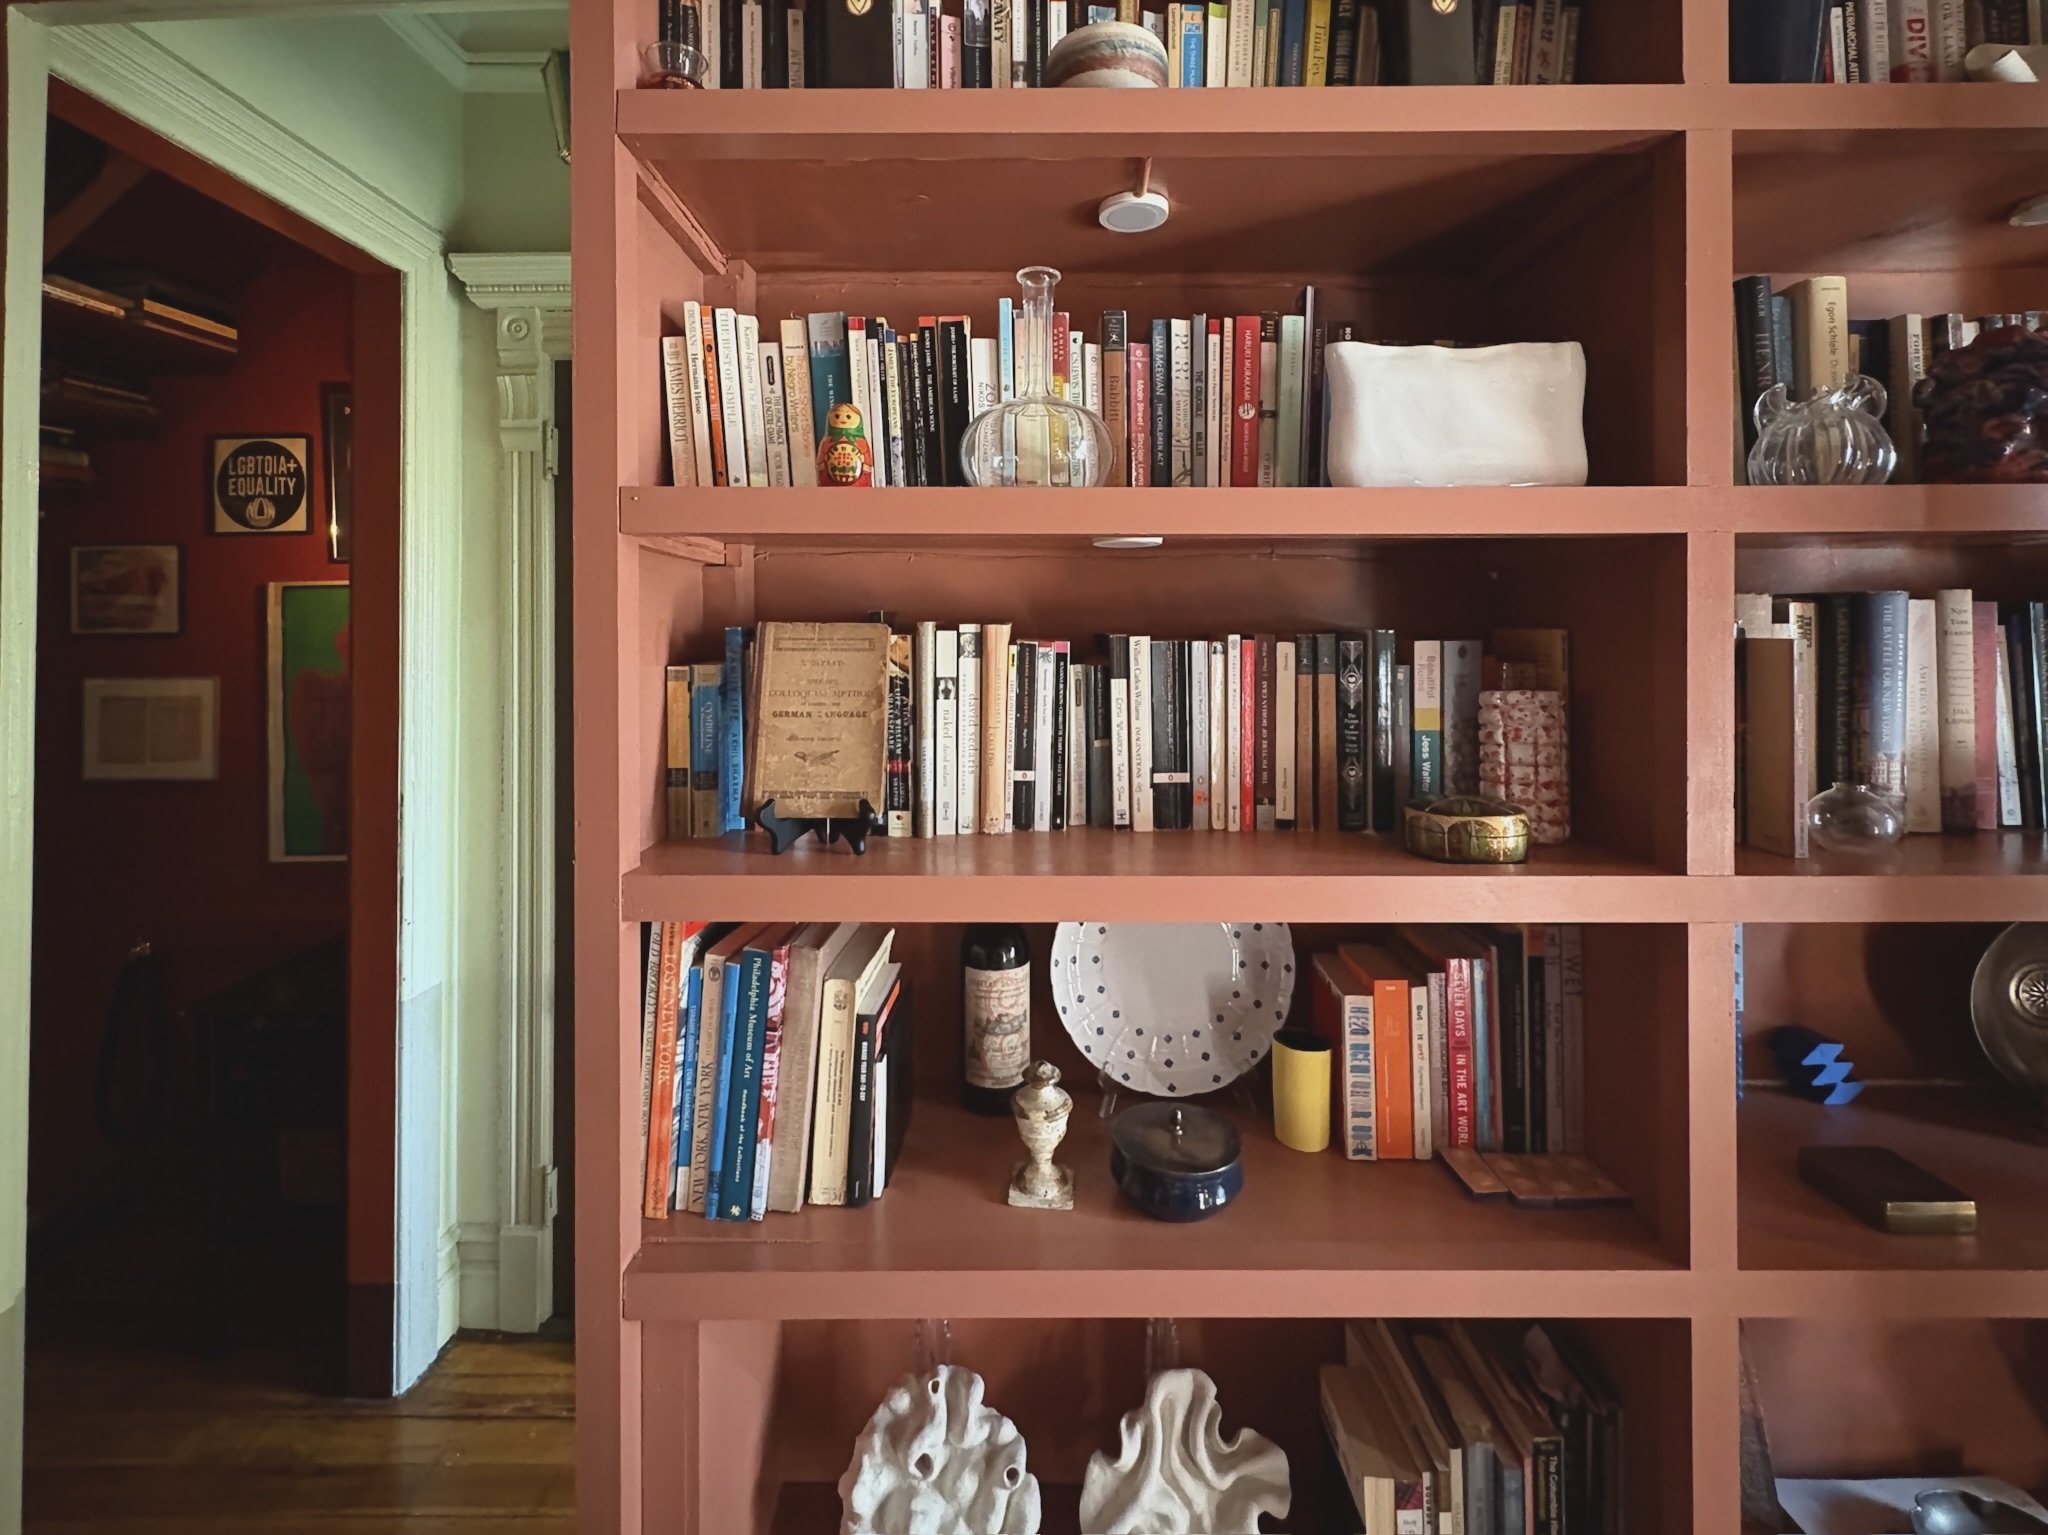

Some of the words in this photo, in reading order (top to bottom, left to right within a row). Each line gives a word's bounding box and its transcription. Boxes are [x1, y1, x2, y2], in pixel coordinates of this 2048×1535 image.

[1314, 24, 1327, 53] Tina
[1845, 2, 1857, 60] PATRIARCHAL
[1310, 55, 1325, 77] Fey
[1756, 285, 1766, 317] UNGER
[1828, 302, 1838, 324] Egon
[687, 309, 697, 347] DEMIAN
[718, 311, 730, 334] THE
[744, 326, 755, 350] Kazuo
[1155, 335, 1163, 353] IAN
[1244, 330, 1252, 357] HARUKI
[1829, 326, 1840, 356] Schiele
[720, 338, 732, 368] BEST
[744, 351, 756, 384] Ishiguro
[796, 355, 807, 372] The
[887, 348, 895, 370] JAMES
[667, 357, 687, 394] JAMES
[689, 353, 701, 389] Hermann
[723, 370, 733, 383] OF
[786, 367, 797, 398] Negro
[796, 373, 808, 395] Best
[1155, 354, 1165, 396] McEWAN
[1195, 371, 1203, 384] THE
[1244, 359, 1252, 400] MURAKAMI
[694, 391, 702, 414] Hesse
[773, 396, 782, 410] THE
[979, 382, 987, 408] NIKOS
[1109, 375, 1120, 422] Babbitt
[1136, 380, 1146, 401] Main
[1195, 386, 1204, 418] CRUCIBLE
[674, 397, 691, 445] HERRIOT
[726, 386, 738, 428] SIMPLE
[790, 399, 800, 433] Writers
[798, 397, 811, 424] Short
[1136, 402, 1146, 426] Street
[766, 405, 775, 445] NOTRE-DAME
[774, 411, 784, 446] HUNCHBACK
[800, 425, 812, 458] Stories
[1136, 433, 1146, 461] Sinclair
[1195, 432, 1203, 456] MILLER
[228, 457, 297, 477] LGBTQIA+
[775, 451, 783, 470] VICTOR
[228, 477, 296, 497] EQUALITY
[775, 471, 783, 486] HUGO
[1883, 604, 1893, 626] THE
[1133, 639, 1142, 667] William
[1836, 608, 1849, 689] GREENWICH
[1883, 627, 1893, 664] BATTLE
[1134, 668, 1142, 690] Carlos
[1417, 664, 1426, 692] Ruins
[1425, 656, 1436, 699] Beautiful
[1882, 666, 1893, 687] FOR
[1918, 664, 1930, 716] AMERICA'S
[731, 697, 739, 721] LIFE
[967, 694, 979, 726] david
[1135, 691, 1143, 721] Williams
[1882, 690, 1892, 716] NEW
[703, 701, 714, 754] CYMBELINE
[887, 693, 896, 750] SHAKESPEARE
[942, 709, 953, 739] naked
[1835, 697, 1850, 752] VILLAGE
[1882, 717, 1892, 743] YORK
[943, 743, 951, 763] david
[968, 731, 978, 775] sedaris
[1421, 735, 1432, 760] Jess
[1919, 721, 1930, 793] CONSTITUTION
[732, 763, 740, 801] SHARMA
[943, 765, 952, 787] sedaris
[1420, 761, 1432, 793] Walter
[651, 933, 661, 958] OLD
[661, 952, 676, 993] LOST
[749, 956, 762, 1012] Philadelphia
[645, 960, 658, 1016] BROOKLYN
[1453, 972, 1467, 1007] SEVEN
[660, 998, 674, 1037] NEW
[689, 1005, 698, 1034] TURKISH
[1415, 1004, 1424, 1021] But
[1454, 1010, 1466, 1038] DAYS
[746, 1012, 758, 1054] Museum
[687, 1035, 695, 1063] DESIGNS
[1456, 1054, 1466, 1065] IN
[657, 1041, 672, 1087] YORK
[699, 1060, 714, 1097] YORK
[743, 1064, 754, 1080] Art
[859, 1074, 867, 1102] DAY-TO-DAY
[1456, 1069, 1467, 1089] THE
[740, 1089, 748, 1123] Handbook
[1457, 1092, 1468, 1112] ART
[697, 1102, 711, 1132] NEW
[1457, 1116, 1469, 1145] WORL
[736, 1146, 744, 1183] Collections
[692, 1176, 706, 1204] NEW
[1549, 1455, 1558, 1472] The
